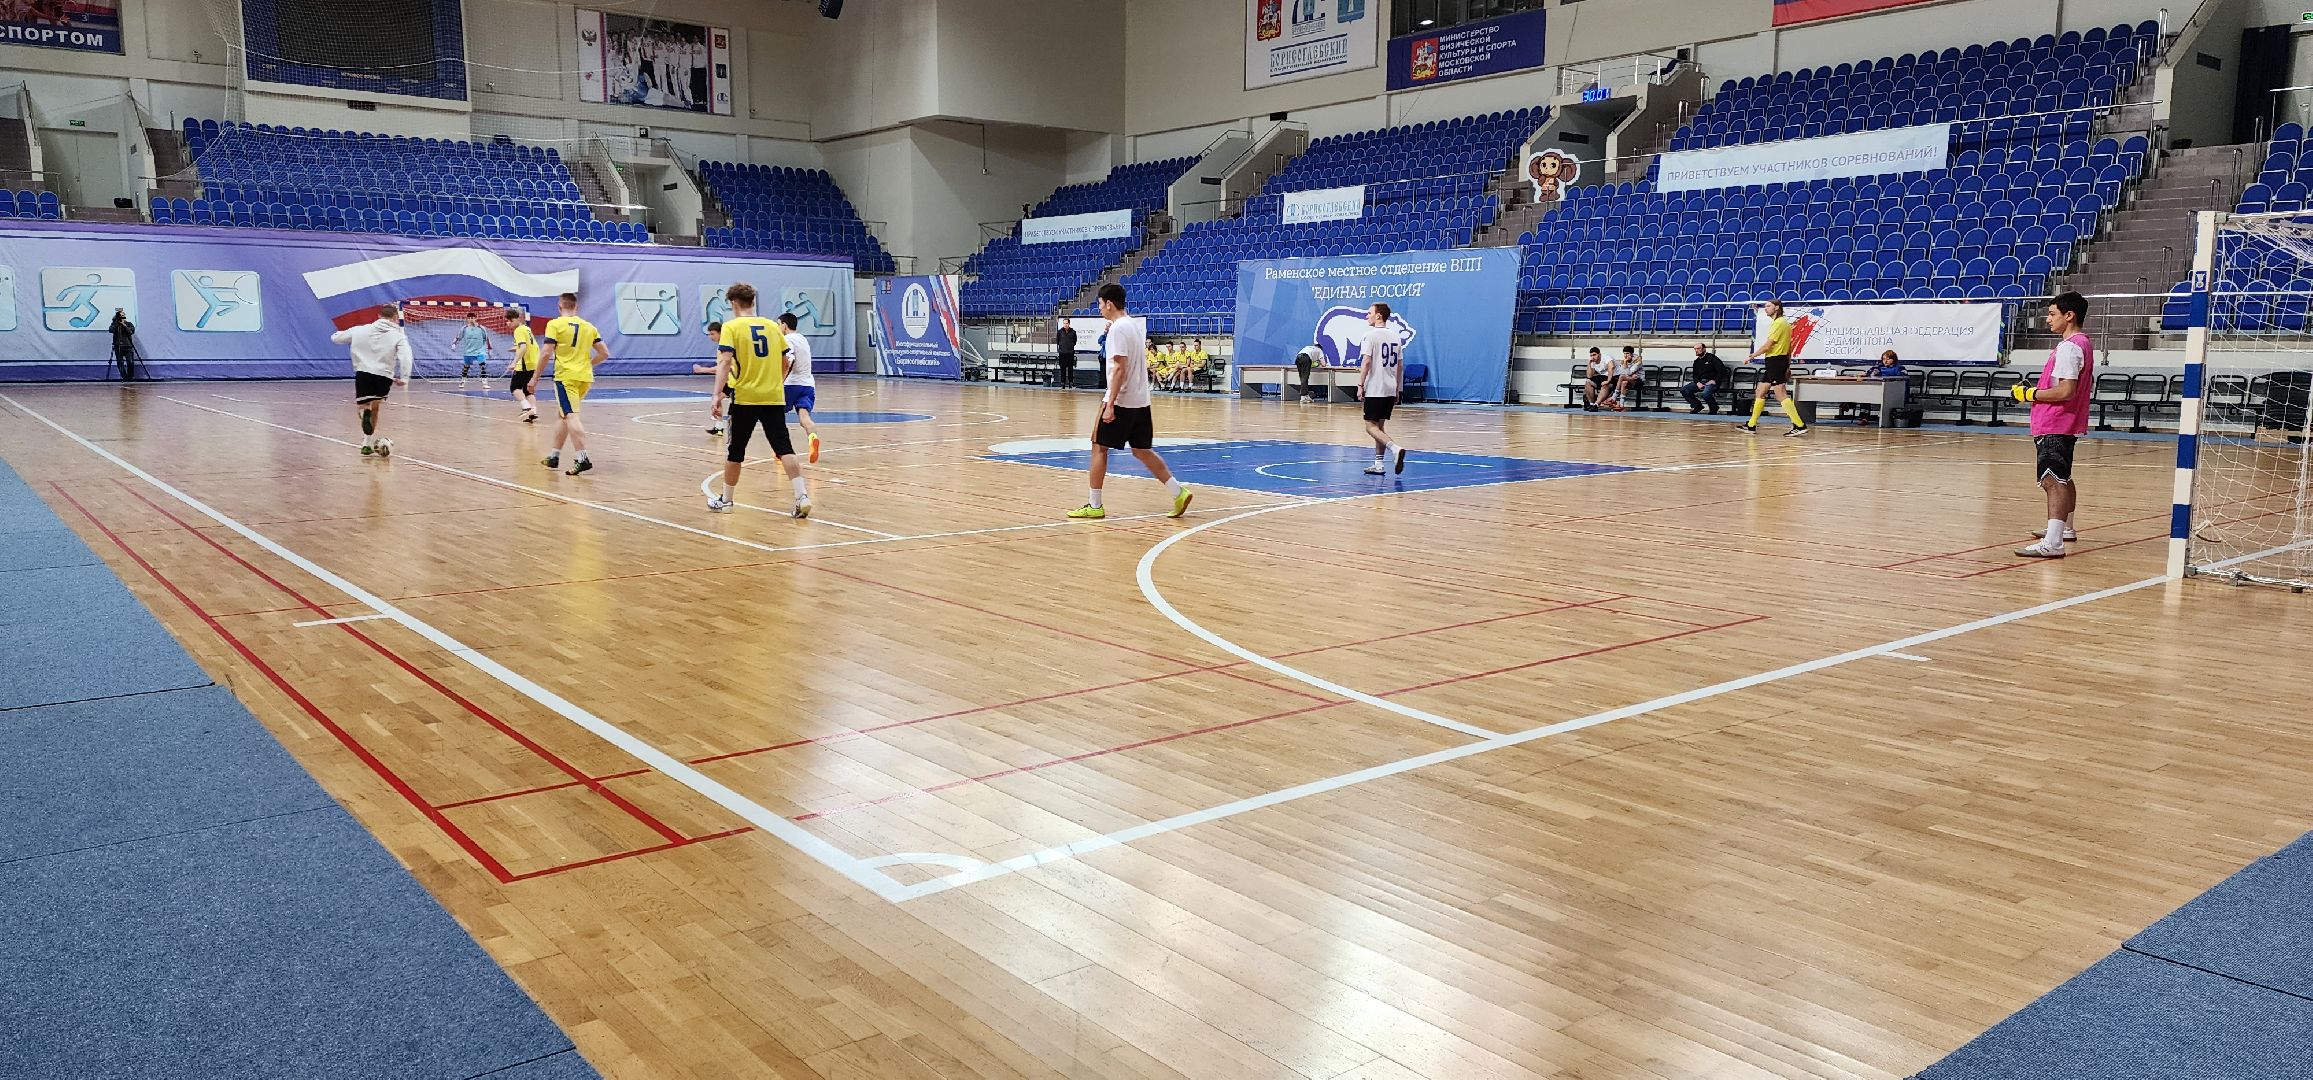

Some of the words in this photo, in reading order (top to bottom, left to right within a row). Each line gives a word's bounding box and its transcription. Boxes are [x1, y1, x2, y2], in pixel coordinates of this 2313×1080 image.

[1440, 25, 1500, 42] МИНИСТЕРСТВО
[1439, 34, 1491, 51] ФИЗИЧЕСКОЙ
[1439, 48, 1477, 60] КУЛЬТУРЫ
[1485, 39, 1517, 52] СПОРТА
[1438, 52, 1491, 69] МОСКОВСКОЙ
[1438, 65, 1473, 77] ОБЛАСТИ
[1667, 165, 1750, 181] ПРИВЕТСТВУЕМ
[1752, 159, 1827, 175] УЧАСТНИКОВ
[1831, 146, 1938, 167] СОРЕВНОВАНИЙ!
[1265, 267, 1325, 280] Раменское
[1327, 264, 1377, 277] местное
[1380, 261, 1447, 276] отделение
[1450, 257, 1483, 272] ВПП
[568, 322, 580, 347] 7
[1825, 327, 1908, 335] НАЦИОНАЛЬНАЯ
[1910, 326, 1974, 337] ФЕДЕРАЦИЯ
[750, 325, 769, 357] 5
[1825, 337, 1893, 346] БАДМИНТОНА
[1381, 342, 1398, 368] 95
[1825, 346, 1862, 355] РОССИИ
